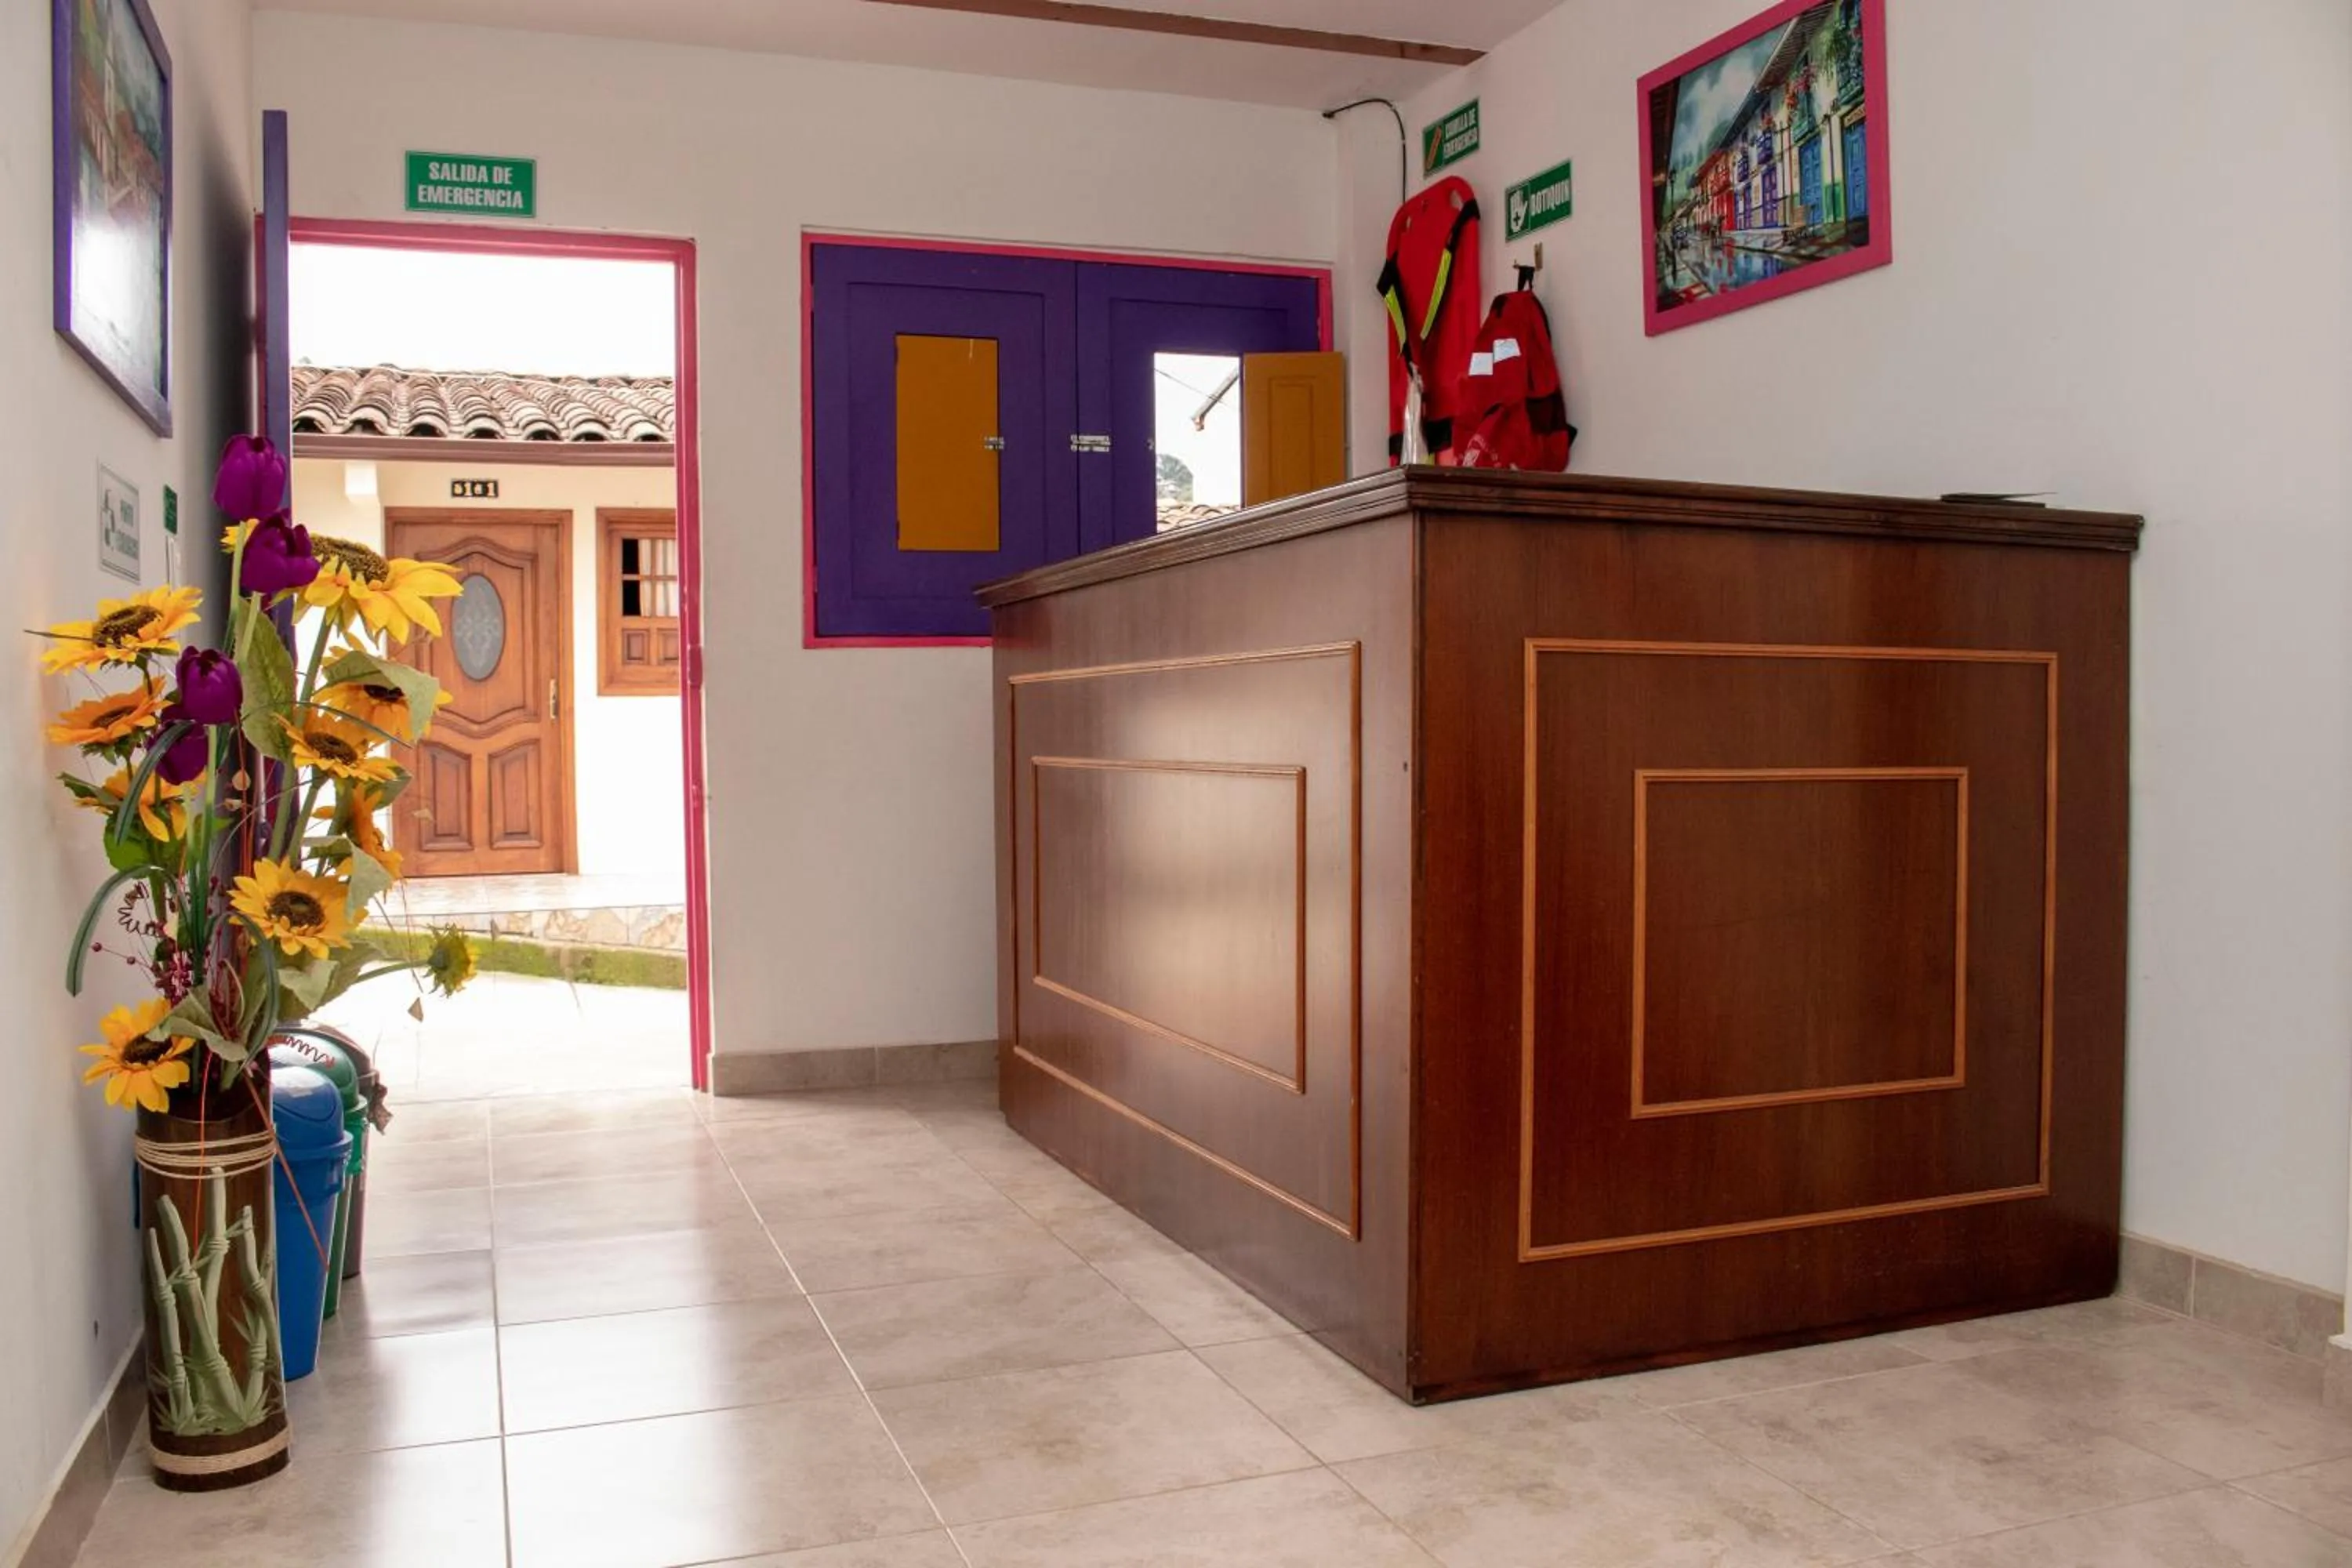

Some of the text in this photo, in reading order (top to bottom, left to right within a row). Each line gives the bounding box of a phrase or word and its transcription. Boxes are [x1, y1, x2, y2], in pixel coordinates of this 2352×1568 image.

[429, 162, 514, 184] SALIDA DE
[418, 184, 523, 209] EMERGENCIA
